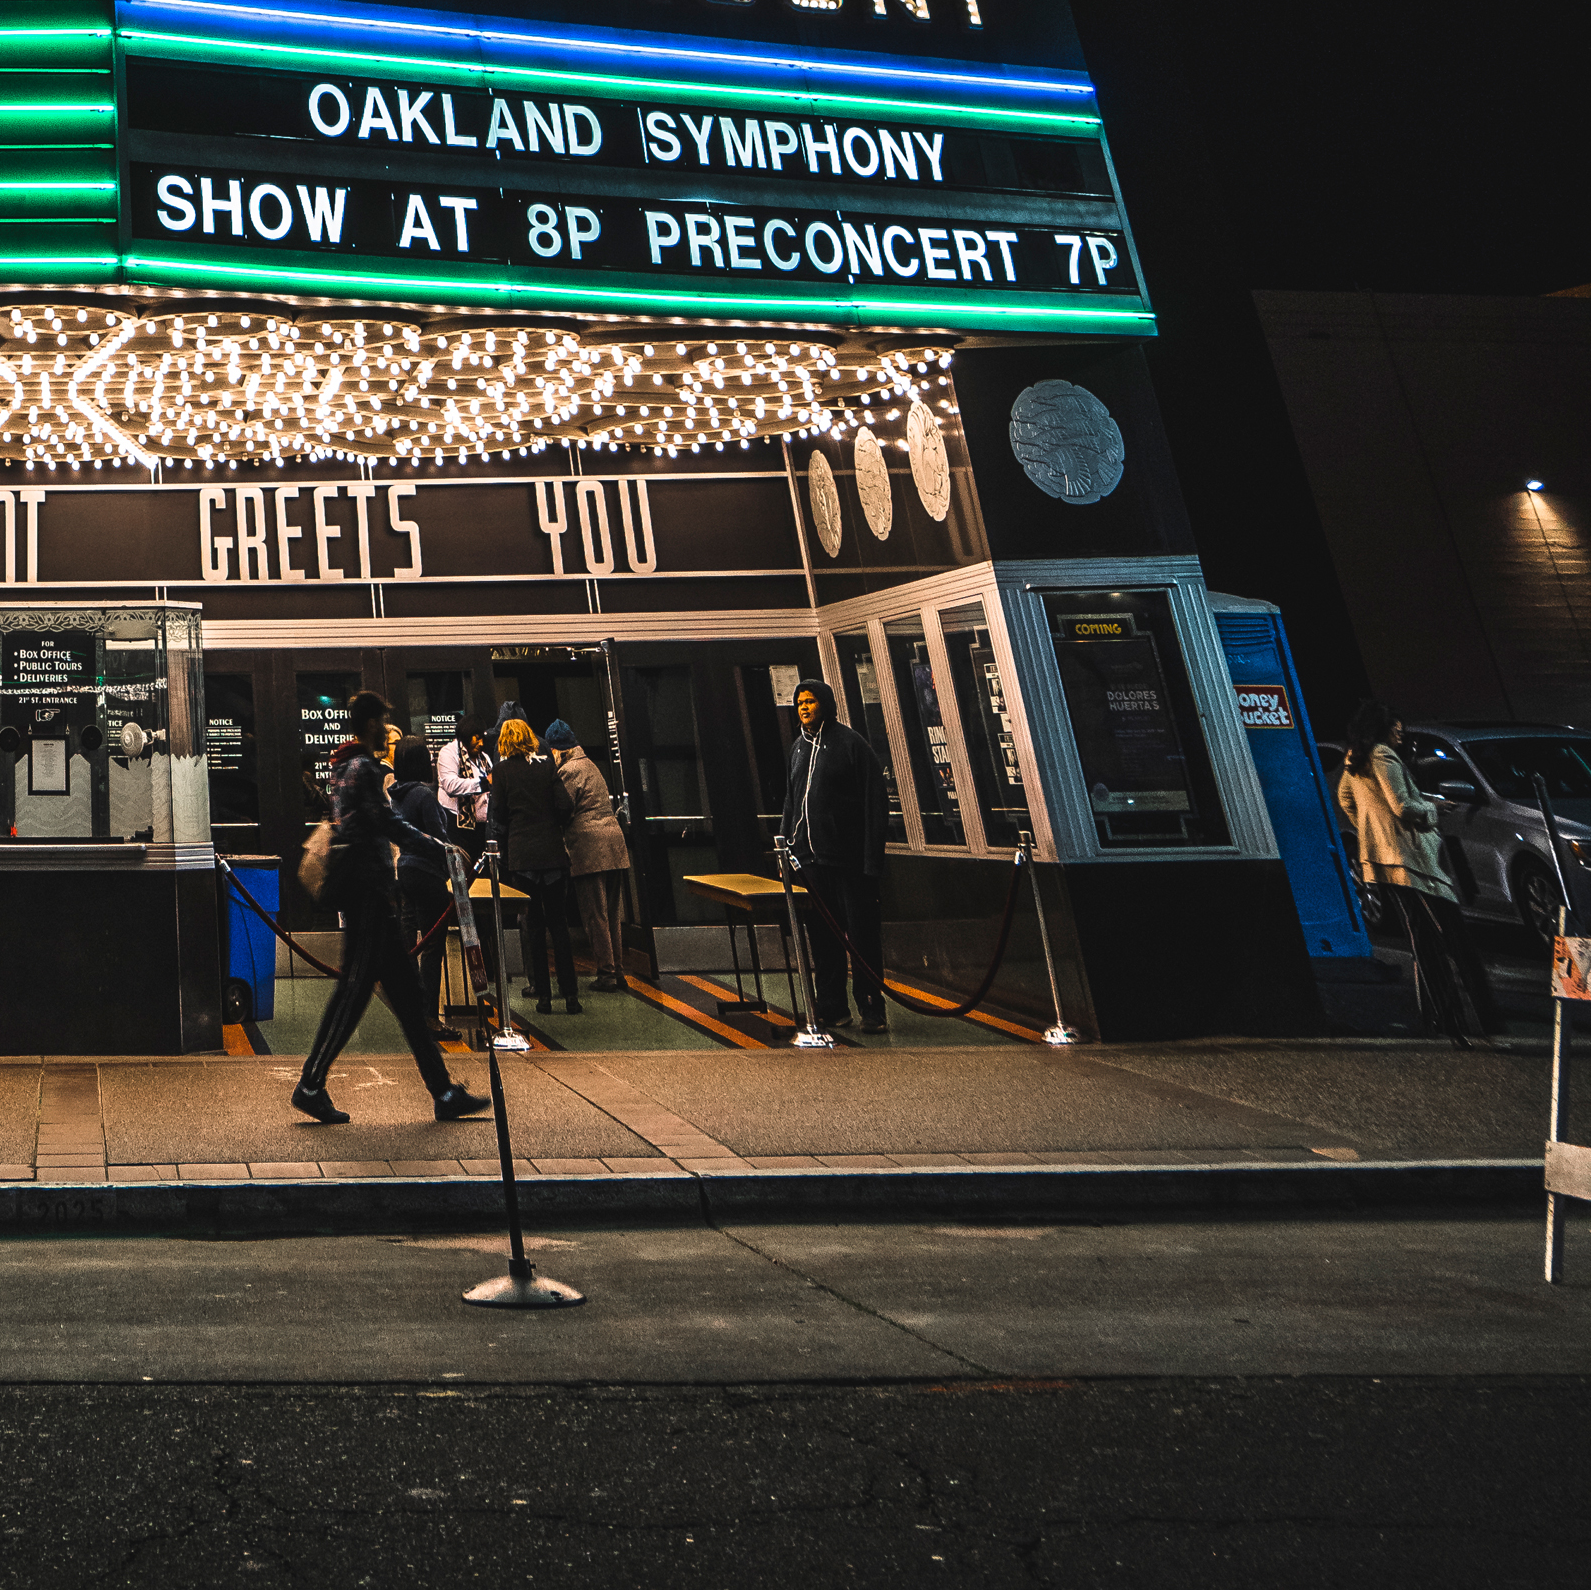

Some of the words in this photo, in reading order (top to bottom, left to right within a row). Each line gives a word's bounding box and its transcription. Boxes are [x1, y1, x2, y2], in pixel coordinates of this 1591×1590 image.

[307, 83, 603, 158] OAKLAND
[647, 110, 946, 182] SYMPHONY
[155, 175, 347, 244] SHOW
[399, 195, 479, 252] AT
[527, 203, 603, 260] 8P
[647, 209, 1020, 283] PRECONCERT
[1055, 233, 1119, 285] 7P
[198, 485, 423, 582] GREETS
[535, 479, 657, 575] YOU
[1075, 623, 1122, 635] COMING
[1107, 690, 1157, 701] DOLORES
[1238, 693, 1279, 712] oney
[431, 715, 456, 723] NOTICE
[1242, 707, 1290, 726] ucket
[323, 722, 341, 731] AND
